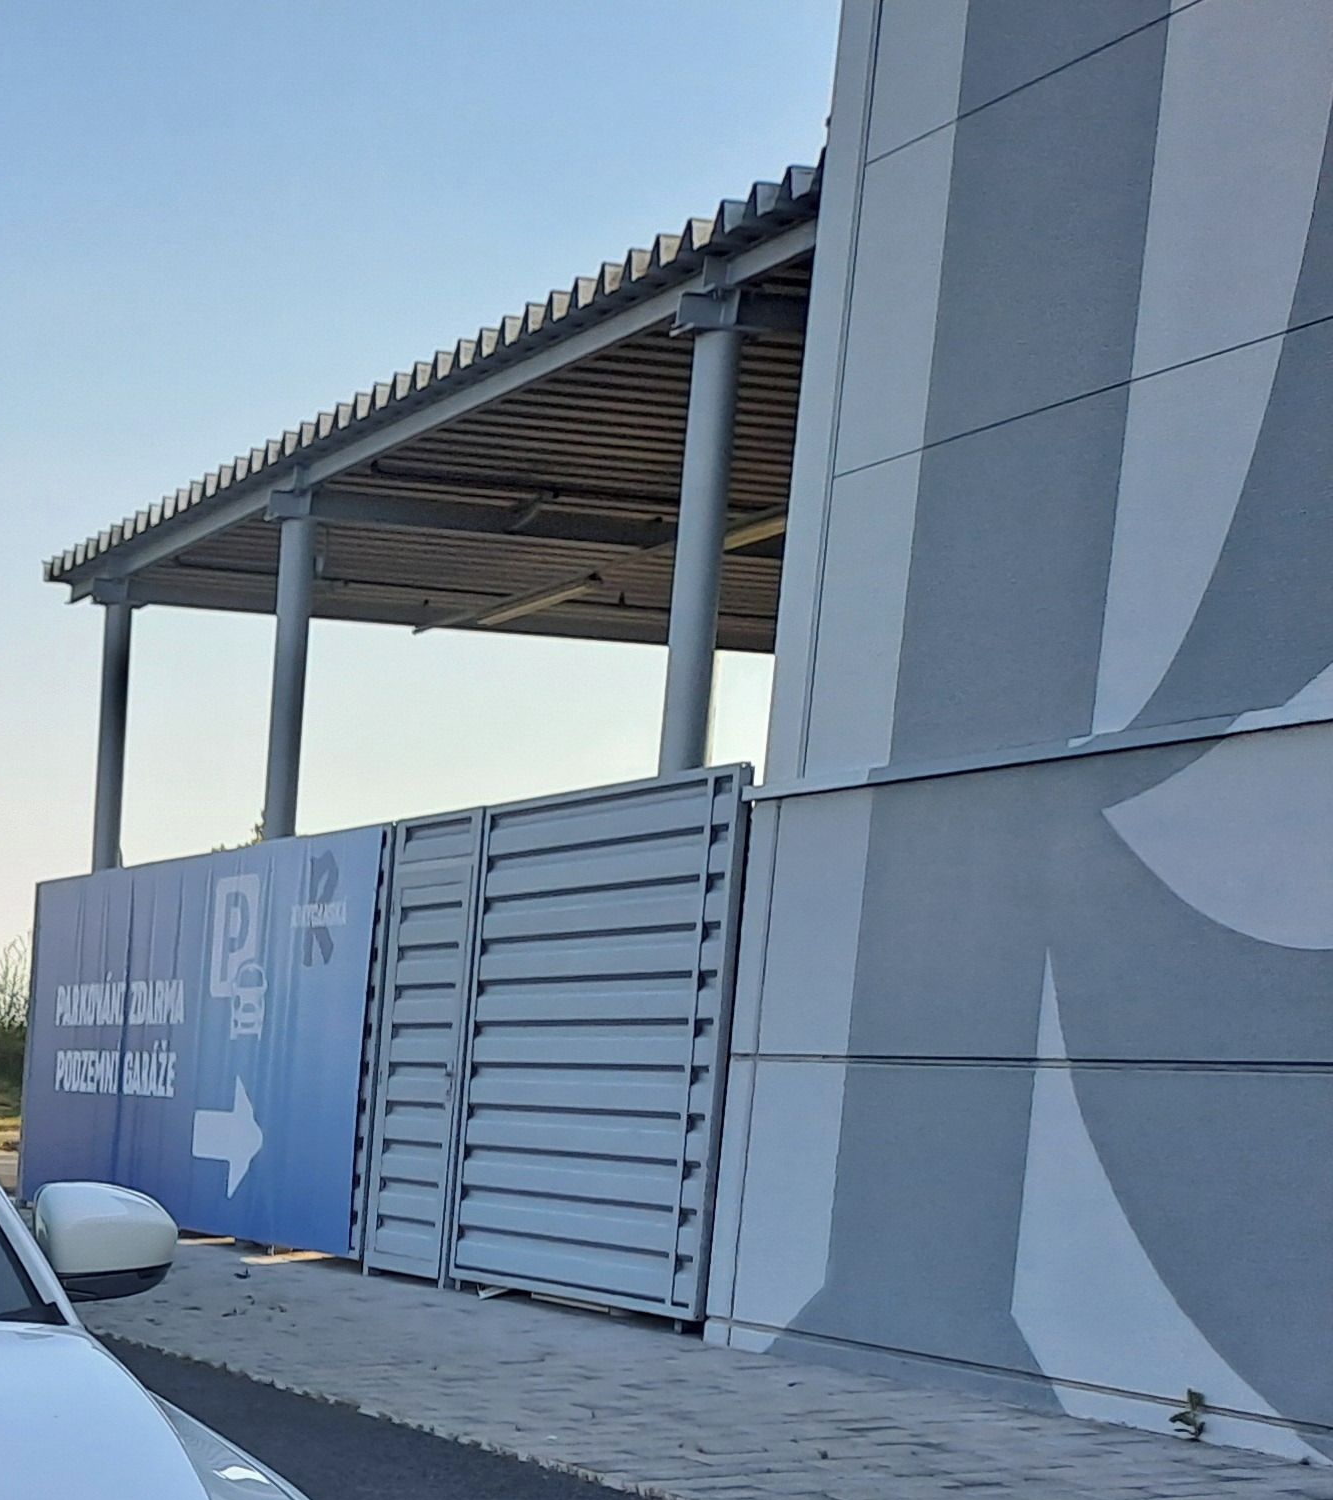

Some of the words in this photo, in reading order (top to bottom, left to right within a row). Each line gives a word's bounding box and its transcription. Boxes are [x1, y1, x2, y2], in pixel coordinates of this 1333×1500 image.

[129, 979, 185, 1026] ZDARMA
[55, 1038, 121, 1095] PODZEMNÍ
[122, 1039, 178, 1098] GARÁŽE
